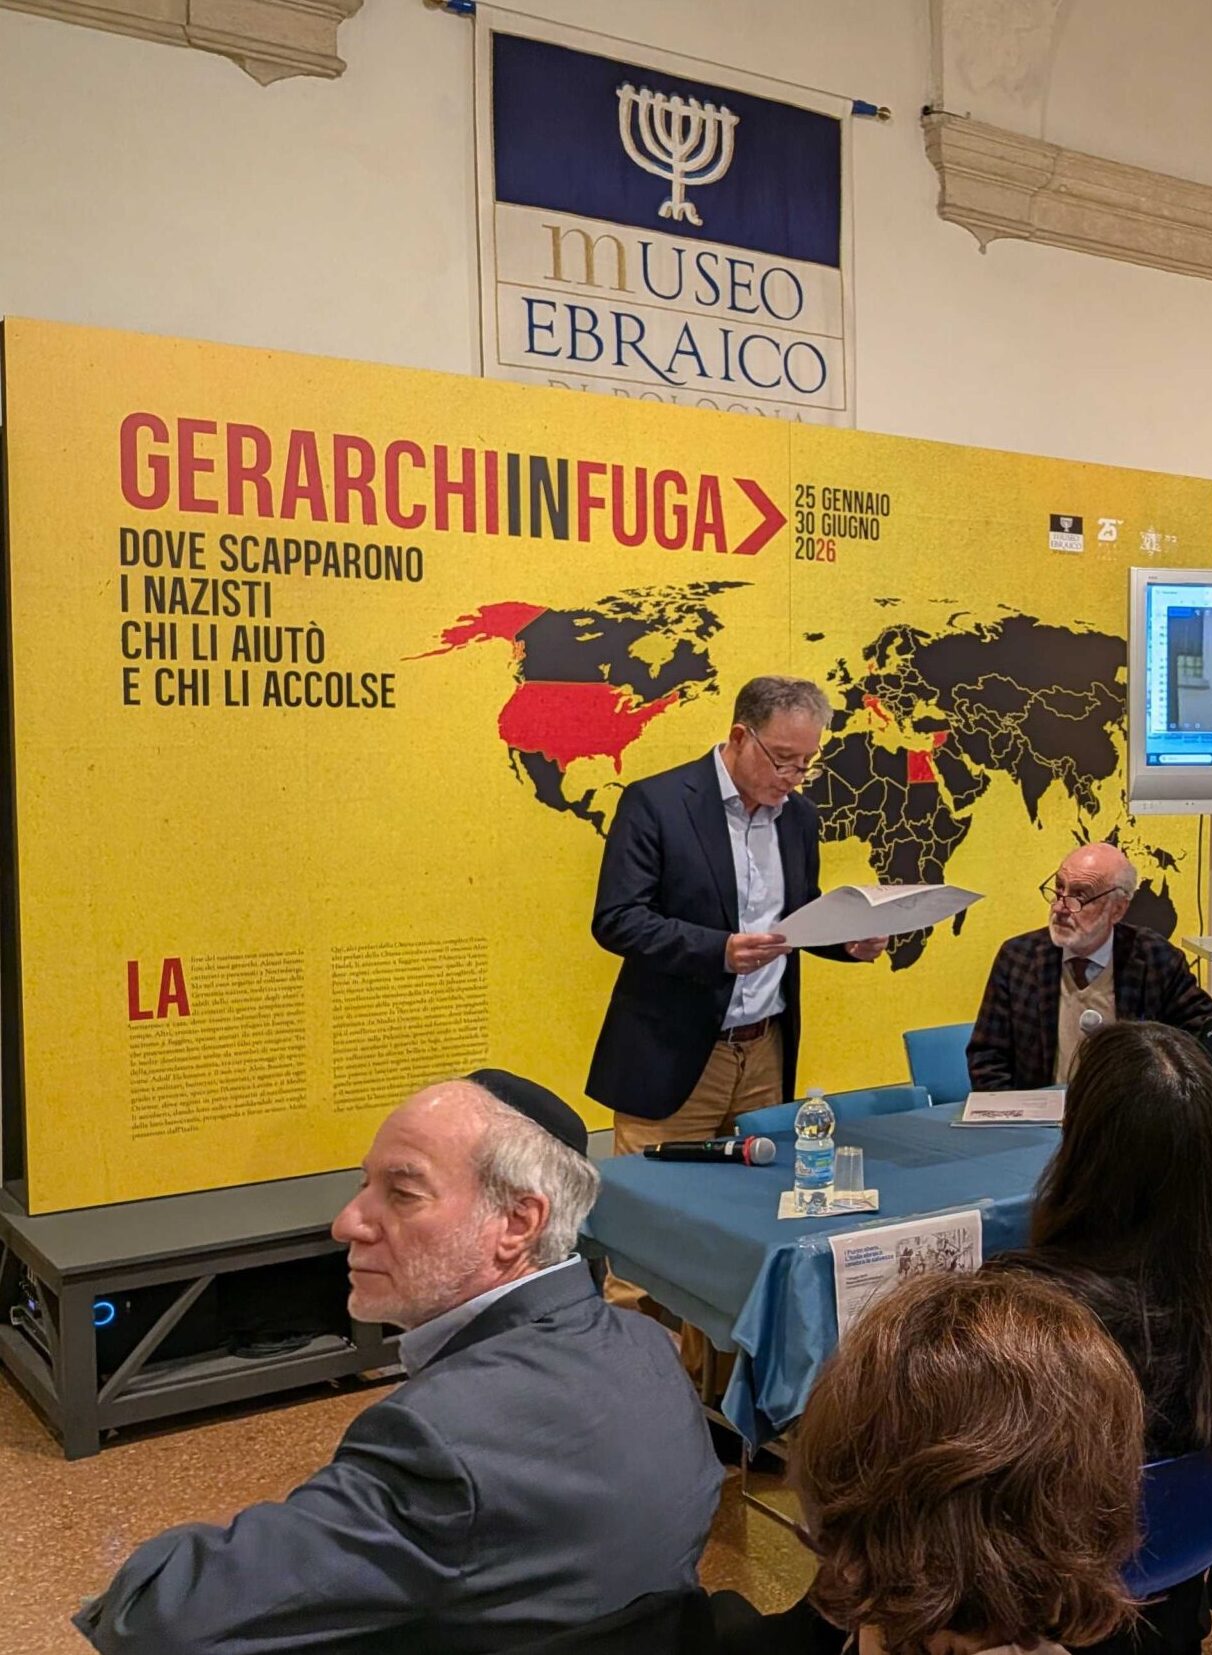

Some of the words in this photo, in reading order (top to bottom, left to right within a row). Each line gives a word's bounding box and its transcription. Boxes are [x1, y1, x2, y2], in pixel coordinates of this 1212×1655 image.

[521, 296, 828, 395] EBRAICO
[795, 484, 816, 509] 25
[822, 487, 890, 517] GENNAIO
[795, 510, 816, 535] 30
[821, 513, 880, 541] GIUGNO
[119, 527, 207, 570] DOVE
[219, 533, 424, 583] SCAPPARONO
[795, 536, 837, 563] 2026
[120, 574, 129, 613] I
[144, 575, 272, 619] NAZISTI
[121, 620, 178, 661] CHI
[192, 623, 218, 661] LI
[231, 620, 326, 665] AIUTÒ
[122, 667, 141, 706] E
[155, 667, 210, 707] CHI
[224, 669, 250, 707] LI
[262, 670, 397, 709] ACCOLSE
[128, 957, 191, 1021] LA
